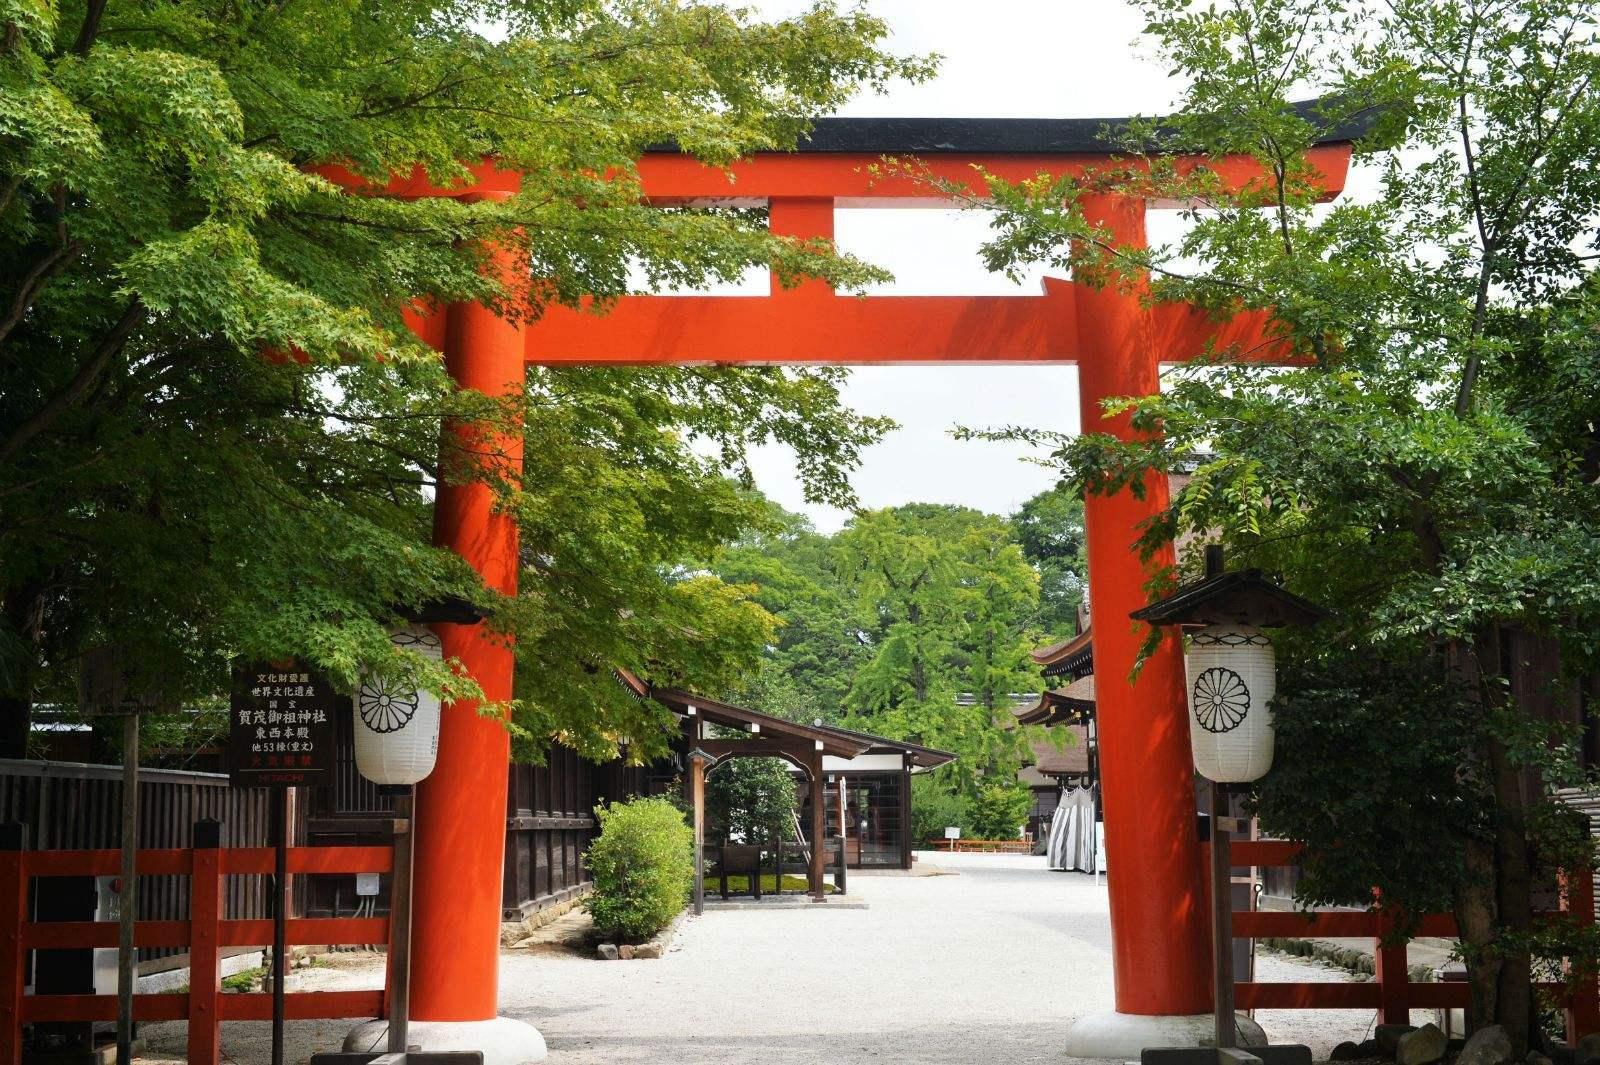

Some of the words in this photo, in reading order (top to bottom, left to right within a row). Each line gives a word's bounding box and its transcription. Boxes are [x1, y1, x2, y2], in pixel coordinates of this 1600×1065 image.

[251, 686, 315, 697] 世界文化遺産
[269, 700, 297, 709] 国宝
[238, 709, 327, 725] 賀茂御祖神社
[255, 727, 310, 739] 東西本殿
